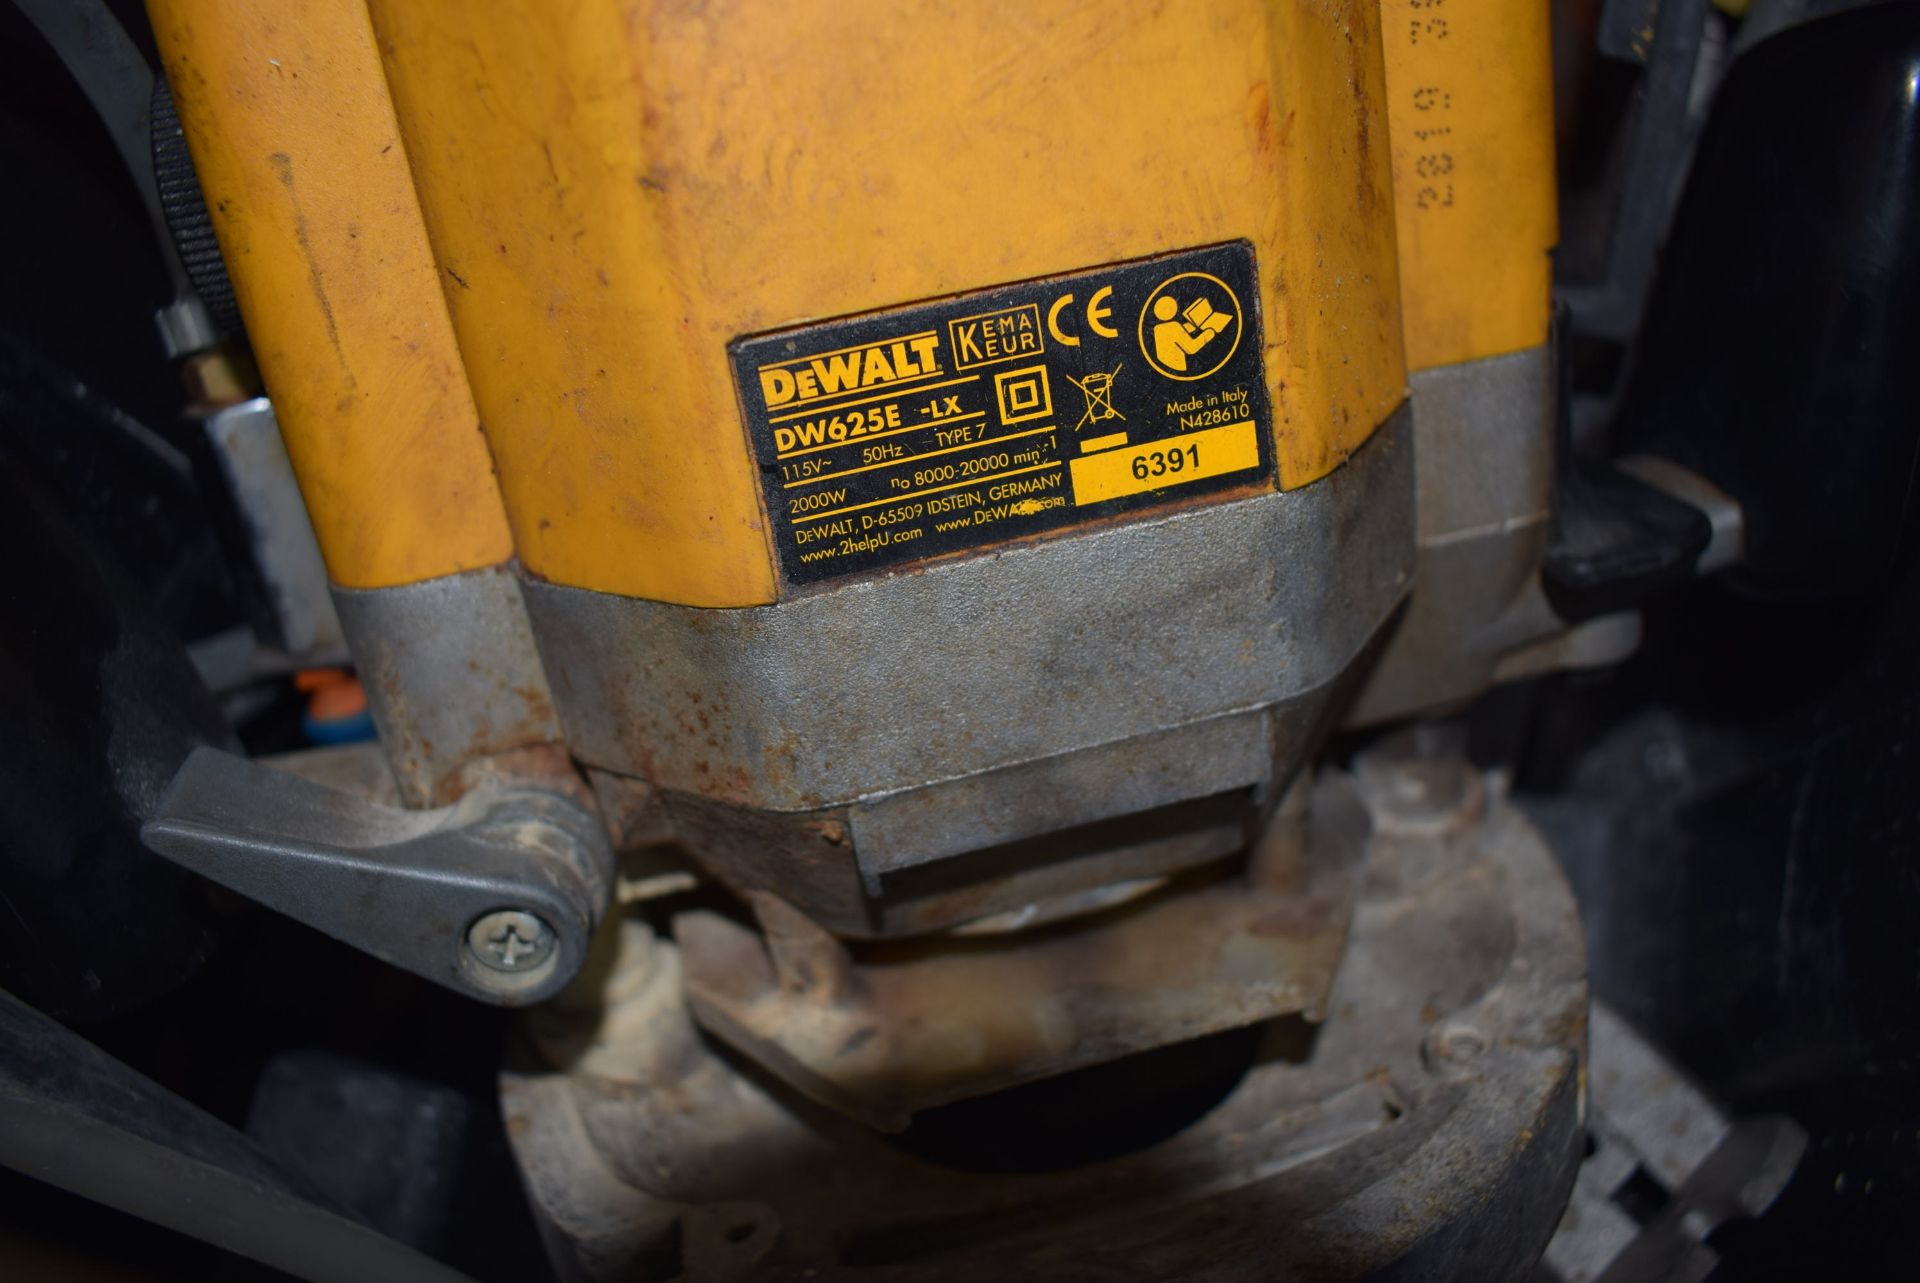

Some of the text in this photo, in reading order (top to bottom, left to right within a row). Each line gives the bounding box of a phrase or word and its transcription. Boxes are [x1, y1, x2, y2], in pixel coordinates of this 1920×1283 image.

[1048, 286, 1118, 347] CE
[1167, 387, 1248, 416] Made in Italy
[1180, 402, 1250, 432] N428610
[775, 405, 901, 452] DW625E
[863, 442, 904, 464] 50Hz
[935, 427, 972, 447] TYPE
[975, 423, 987, 440] 7
[1132, 444, 1201, 480] 6391
[789, 488, 847, 514] 2000W
[914, 453, 1010, 487] 8000-20000
[862, 504, 924, 530] D-65509
[927, 490, 985, 517] IDSTEIN,
[989, 473, 1062, 502] GERMANY
[800, 527, 923, 563] www.2helpU.com
